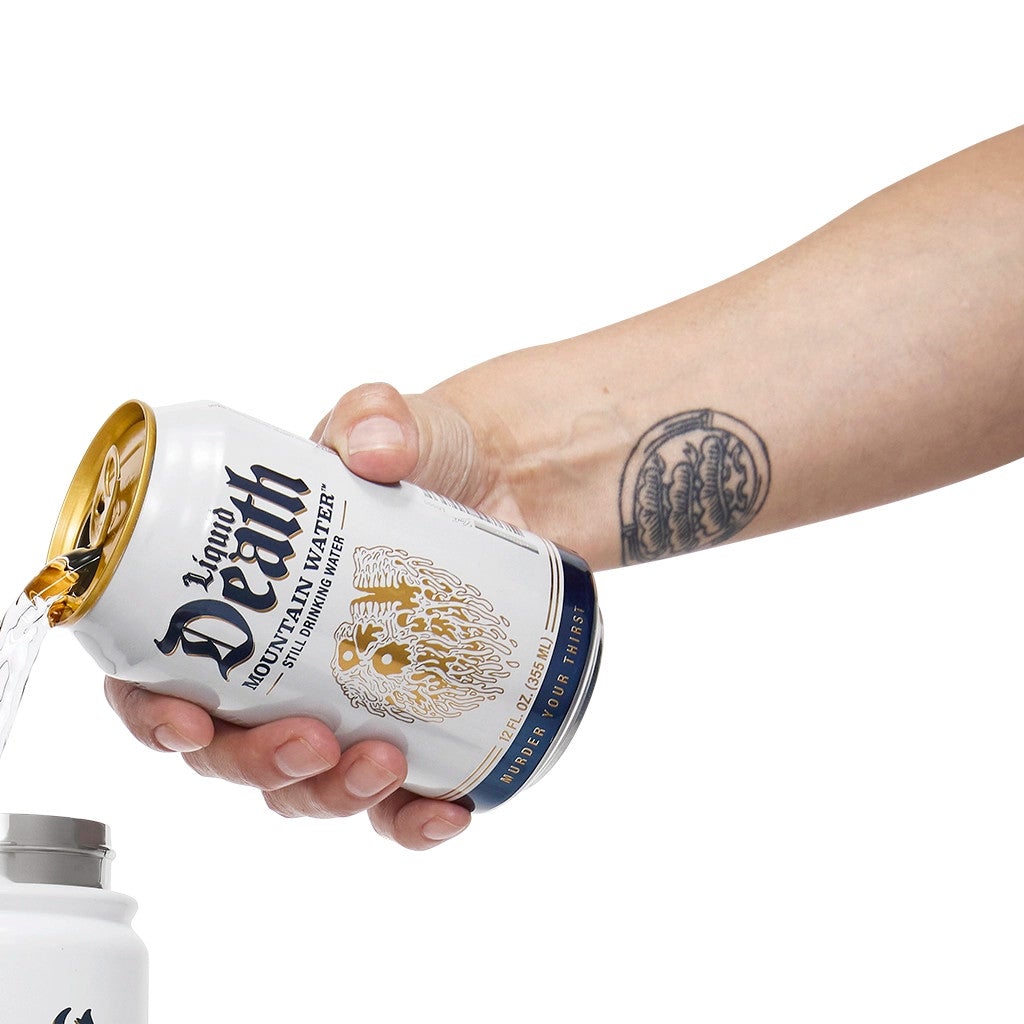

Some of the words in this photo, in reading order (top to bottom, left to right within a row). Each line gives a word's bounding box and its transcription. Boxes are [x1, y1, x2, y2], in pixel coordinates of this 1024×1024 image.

[154, 463, 312, 682] Death
[182, 507, 236, 593] Liquid
[282, 639, 307, 669] STILL
[299, 577, 332, 637] DRINKING
[323, 535, 345, 577] WATER
[242, 576, 314, 690] MOUNTAIN
[499, 730, 513, 743] 12
[506, 714, 524, 730] FL.
[516, 693, 533, 712] OZ.
[525, 662, 545, 691] (355
[536, 636, 553, 661] ML)
[499, 726, 546, 784] MURDER
[541, 674, 570, 718] YOUR
[563, 605, 585, 665] THIRST
